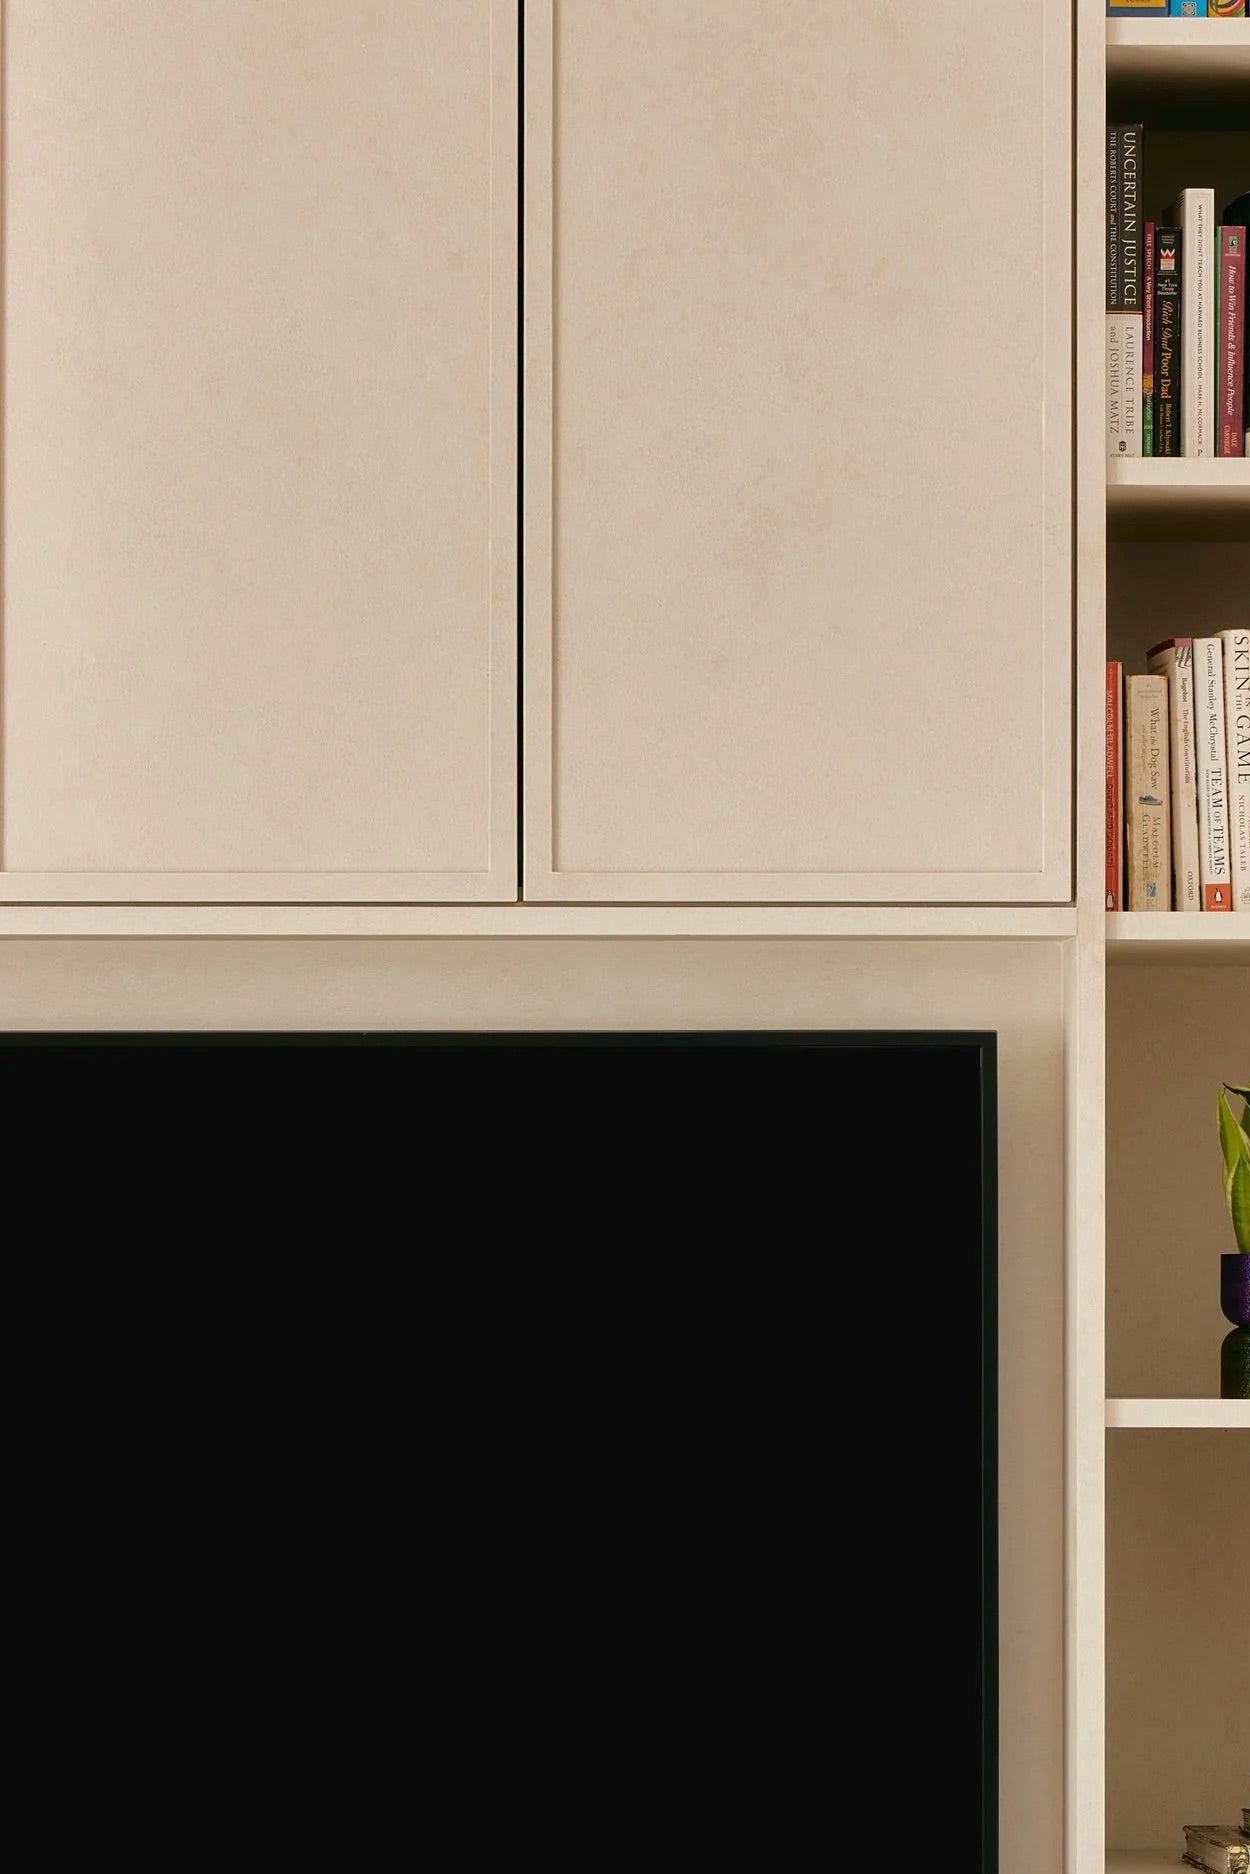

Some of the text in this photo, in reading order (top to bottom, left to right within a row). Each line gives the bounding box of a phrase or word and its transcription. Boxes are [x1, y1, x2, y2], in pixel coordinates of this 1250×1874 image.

[1122, 132, 1137, 305] UNCERTAIN JUSTICE
[1225, 265, 1237, 416] How to Win Friends & Influence People
[1234, 636, 1250, 692] SKIN
[1211, 768, 1226, 875] TEAM OF TEAMS
